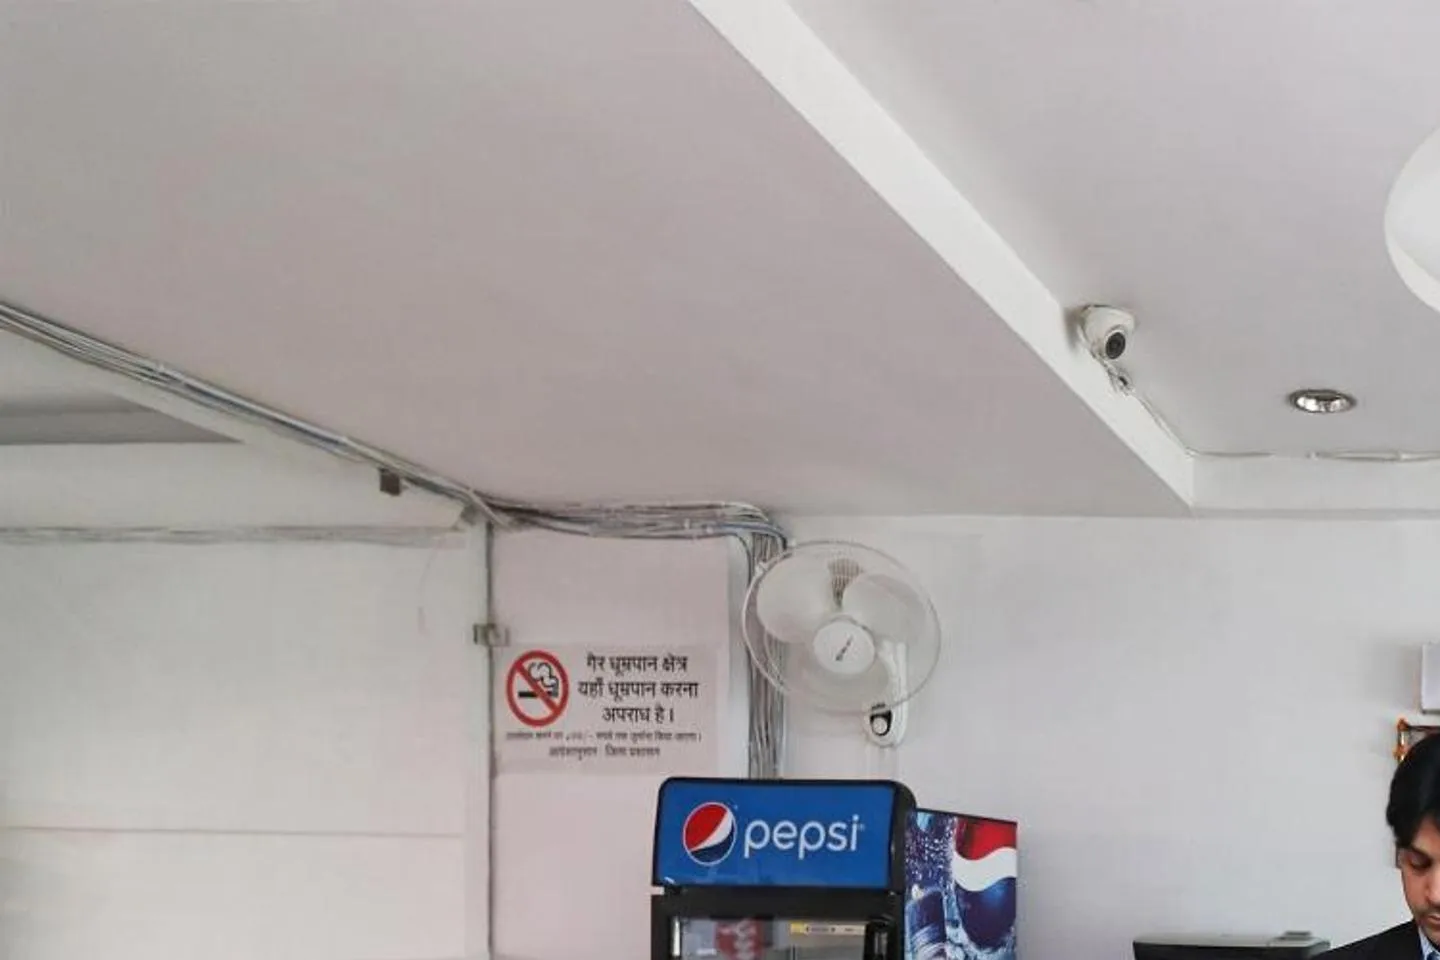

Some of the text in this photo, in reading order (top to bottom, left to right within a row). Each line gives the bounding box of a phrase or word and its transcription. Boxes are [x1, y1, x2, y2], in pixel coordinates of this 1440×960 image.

[660, 681, 698, 698] करना
[602, 706, 650, 722] अपराध
[744, 814, 859, 860] pepsi
